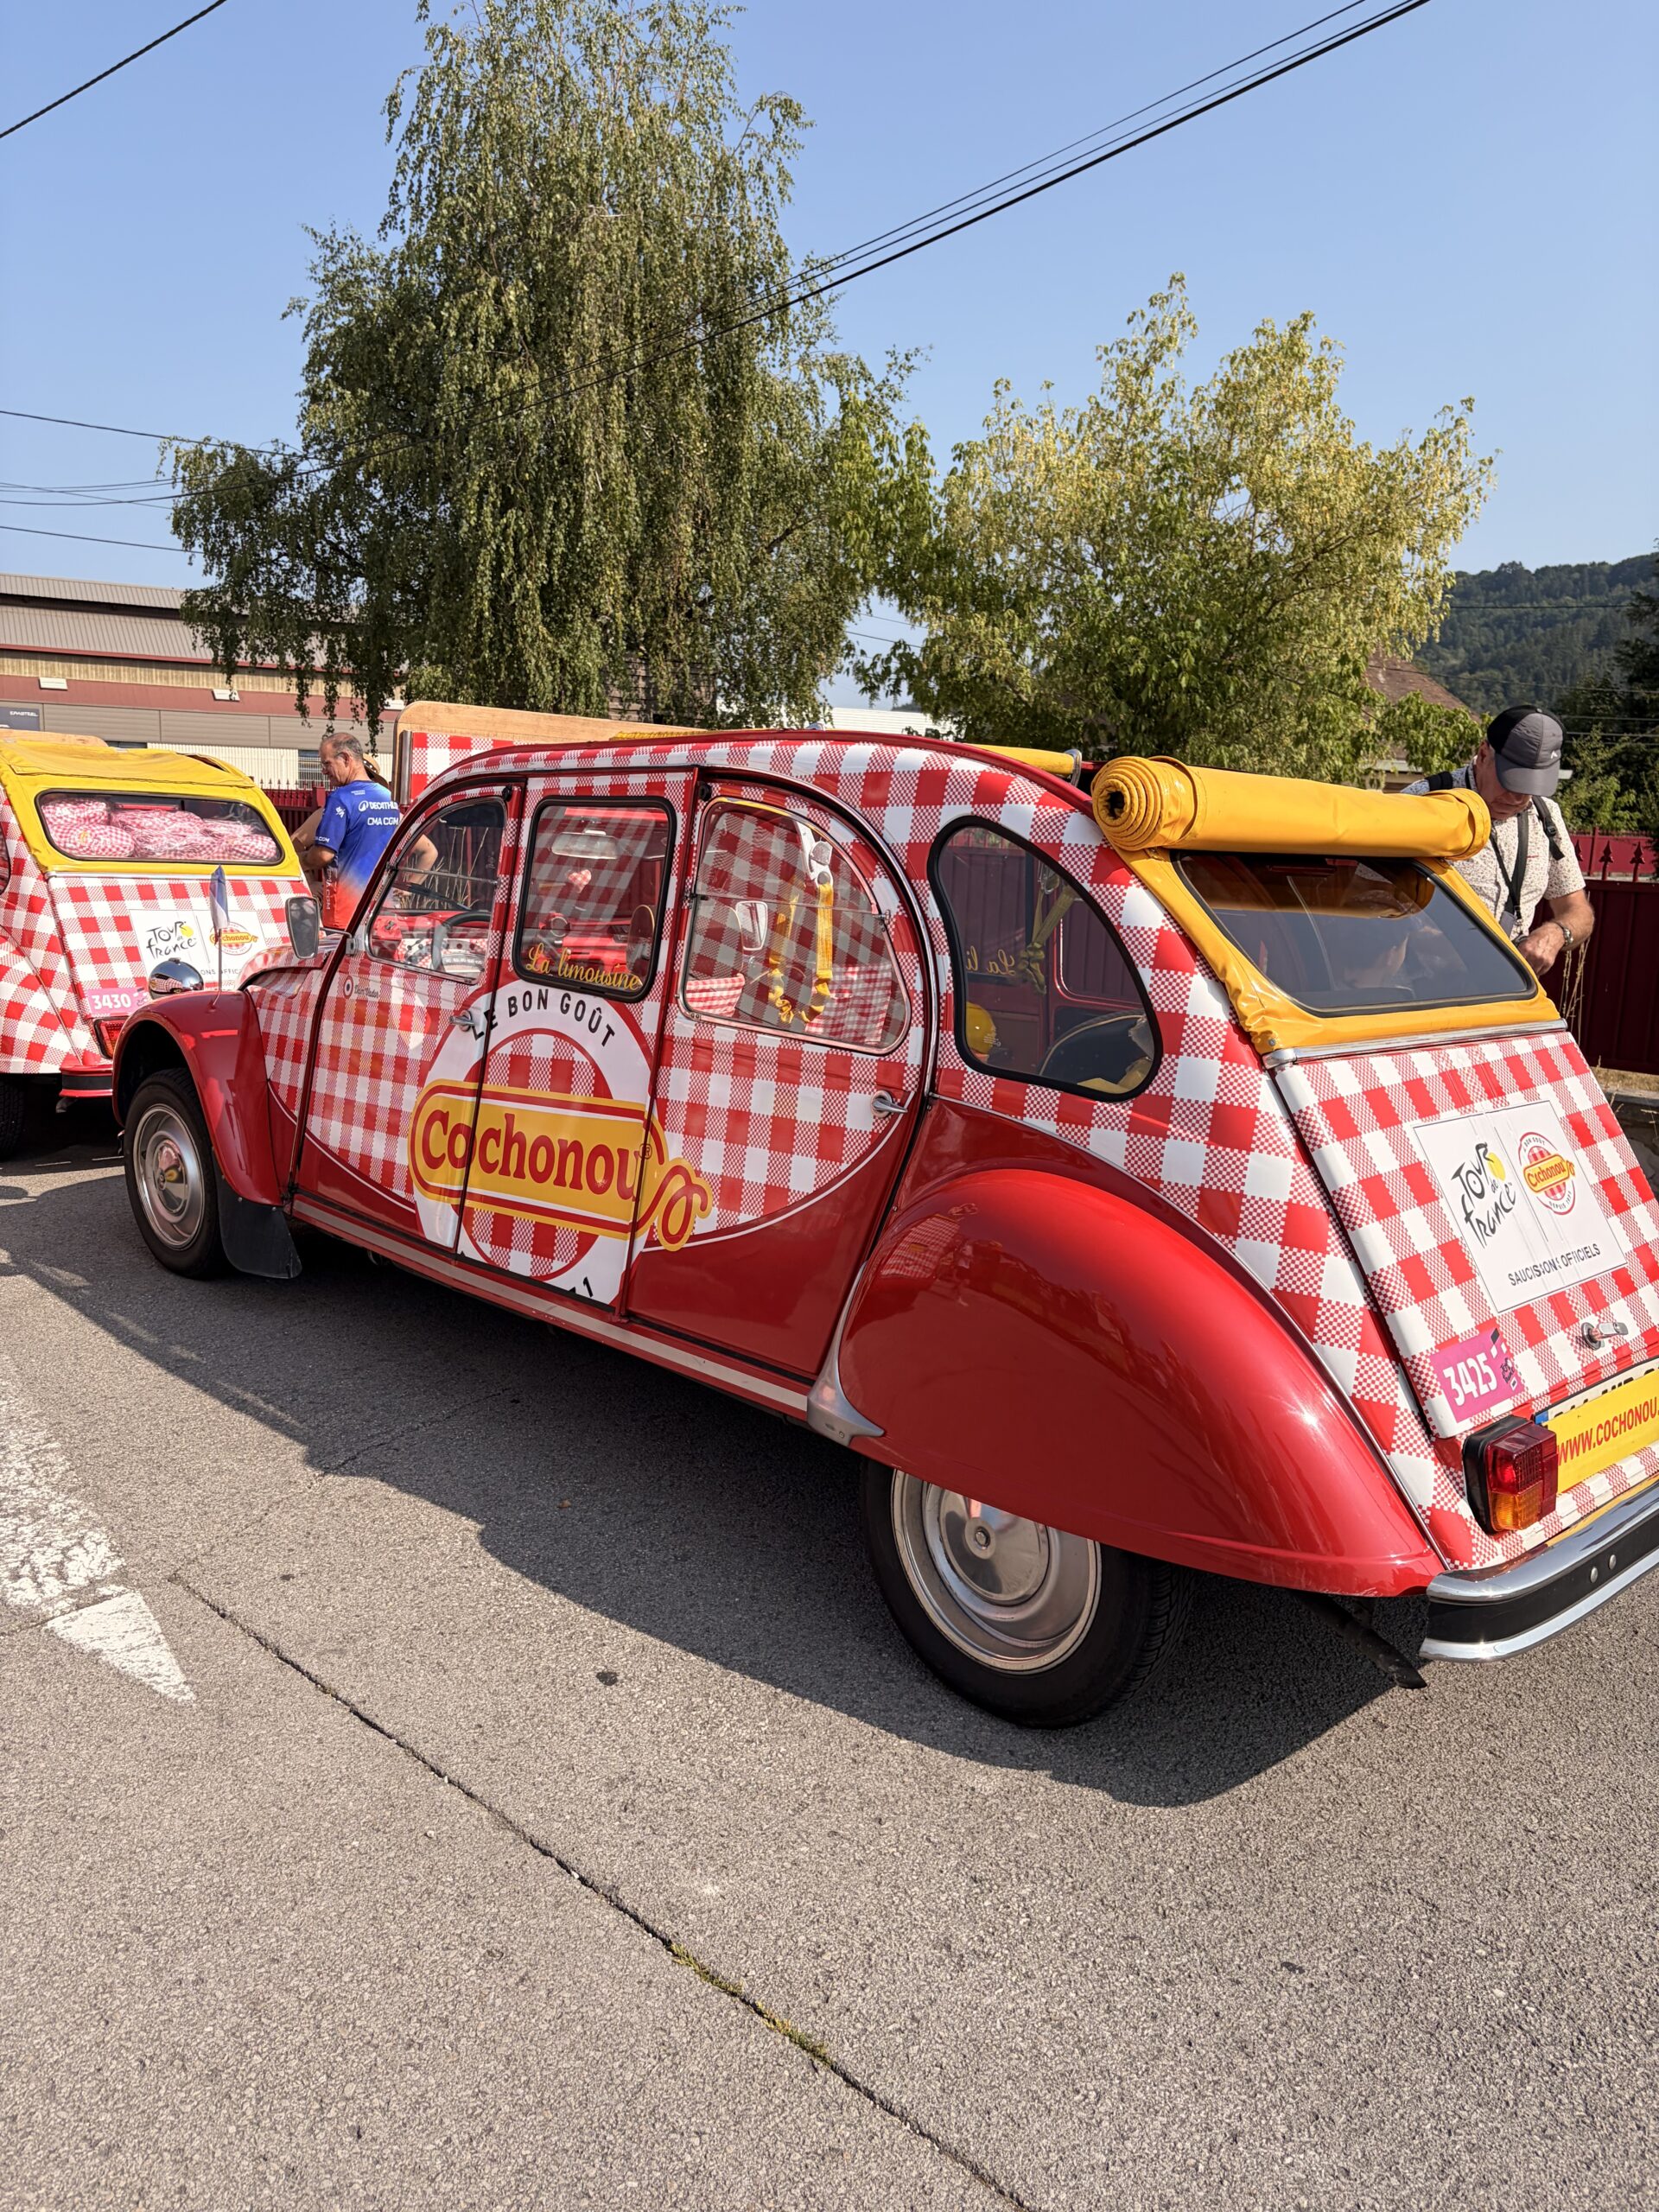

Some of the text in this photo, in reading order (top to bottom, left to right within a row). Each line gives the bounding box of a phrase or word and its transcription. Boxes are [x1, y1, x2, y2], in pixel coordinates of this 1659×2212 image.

[525, 943, 643, 991] La limousine
[92, 994, 131, 1009] 3430
[472, 989, 615, 1046] LE BON GOÛT
[422, 1109, 641, 1203] Cochonou
[1442, 1352, 1497, 1406] 3425
